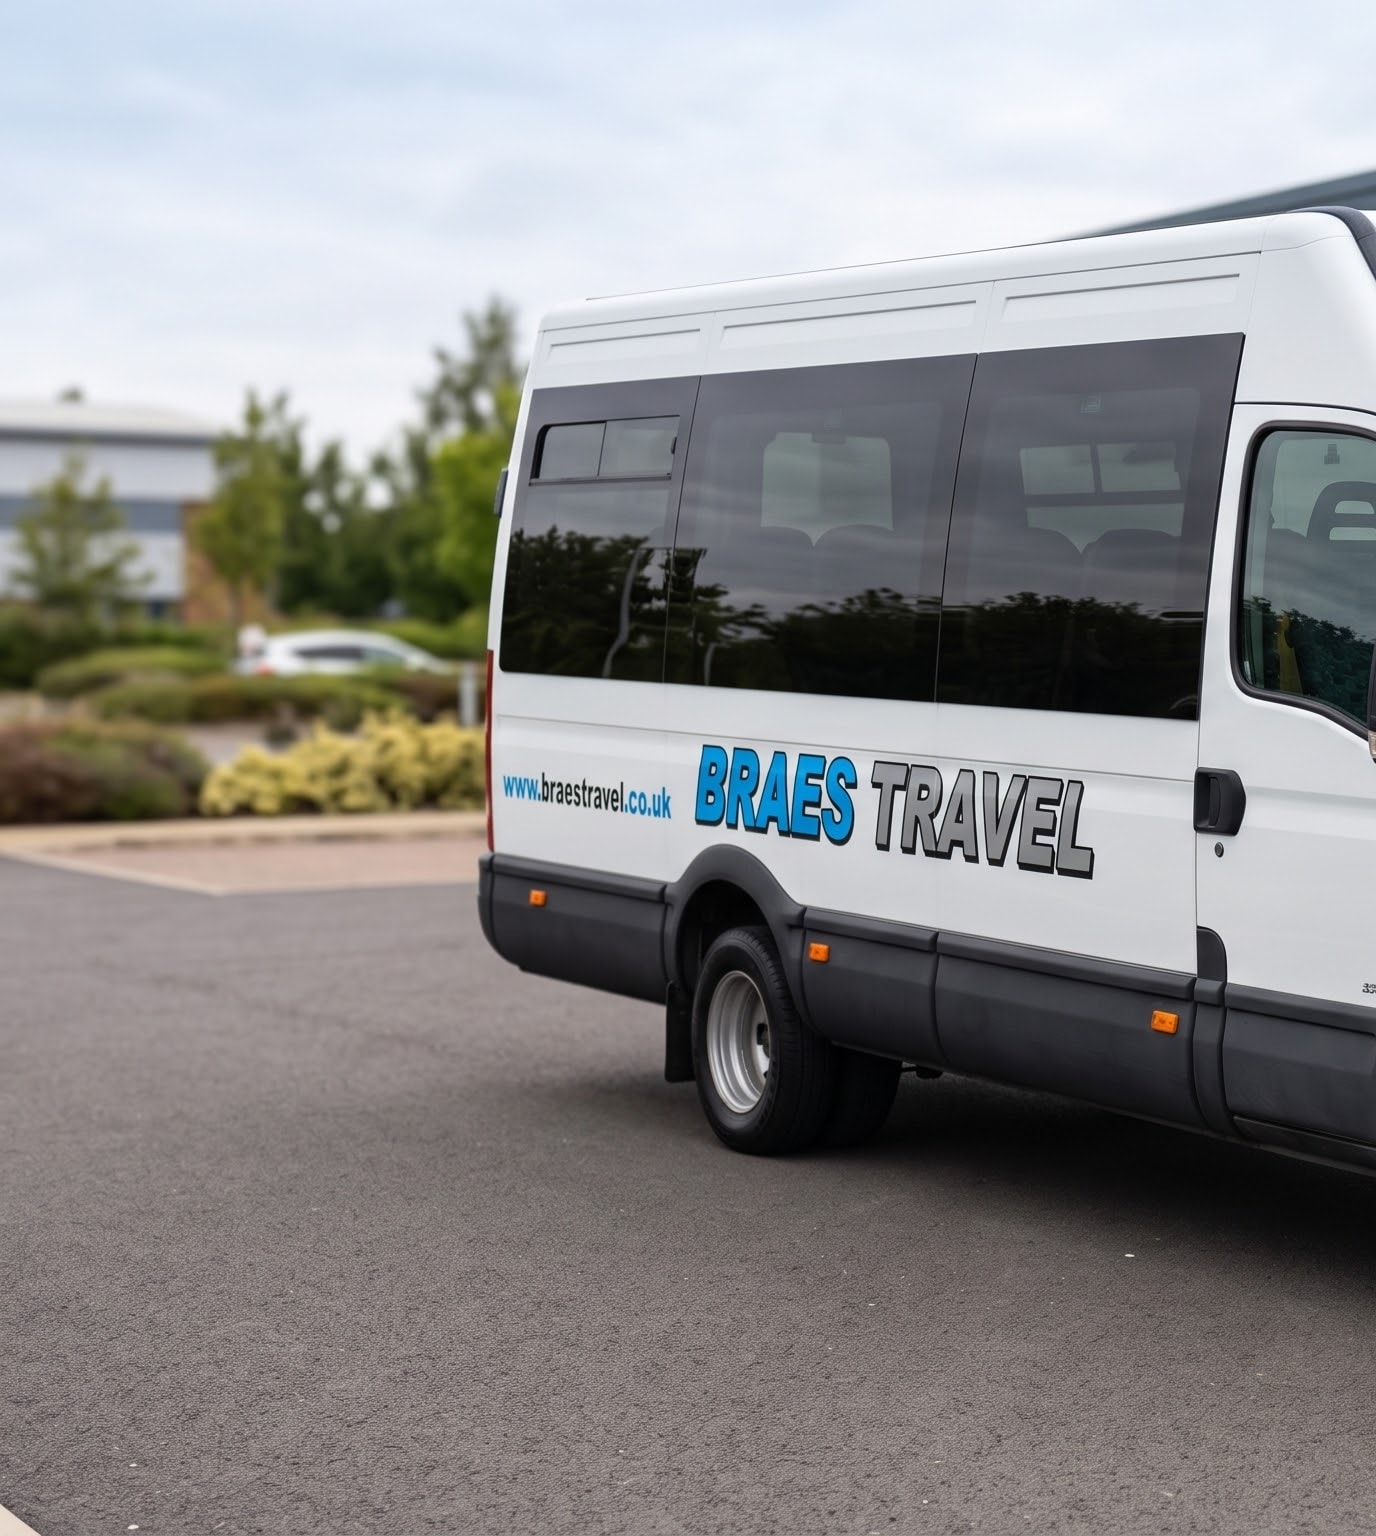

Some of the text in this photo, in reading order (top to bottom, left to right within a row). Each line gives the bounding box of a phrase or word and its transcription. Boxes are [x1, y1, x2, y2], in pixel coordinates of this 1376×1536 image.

[503, 772, 672, 819] www.braestravel.co.uk
[695, 744, 1095, 880] BRAES TRAVEL
